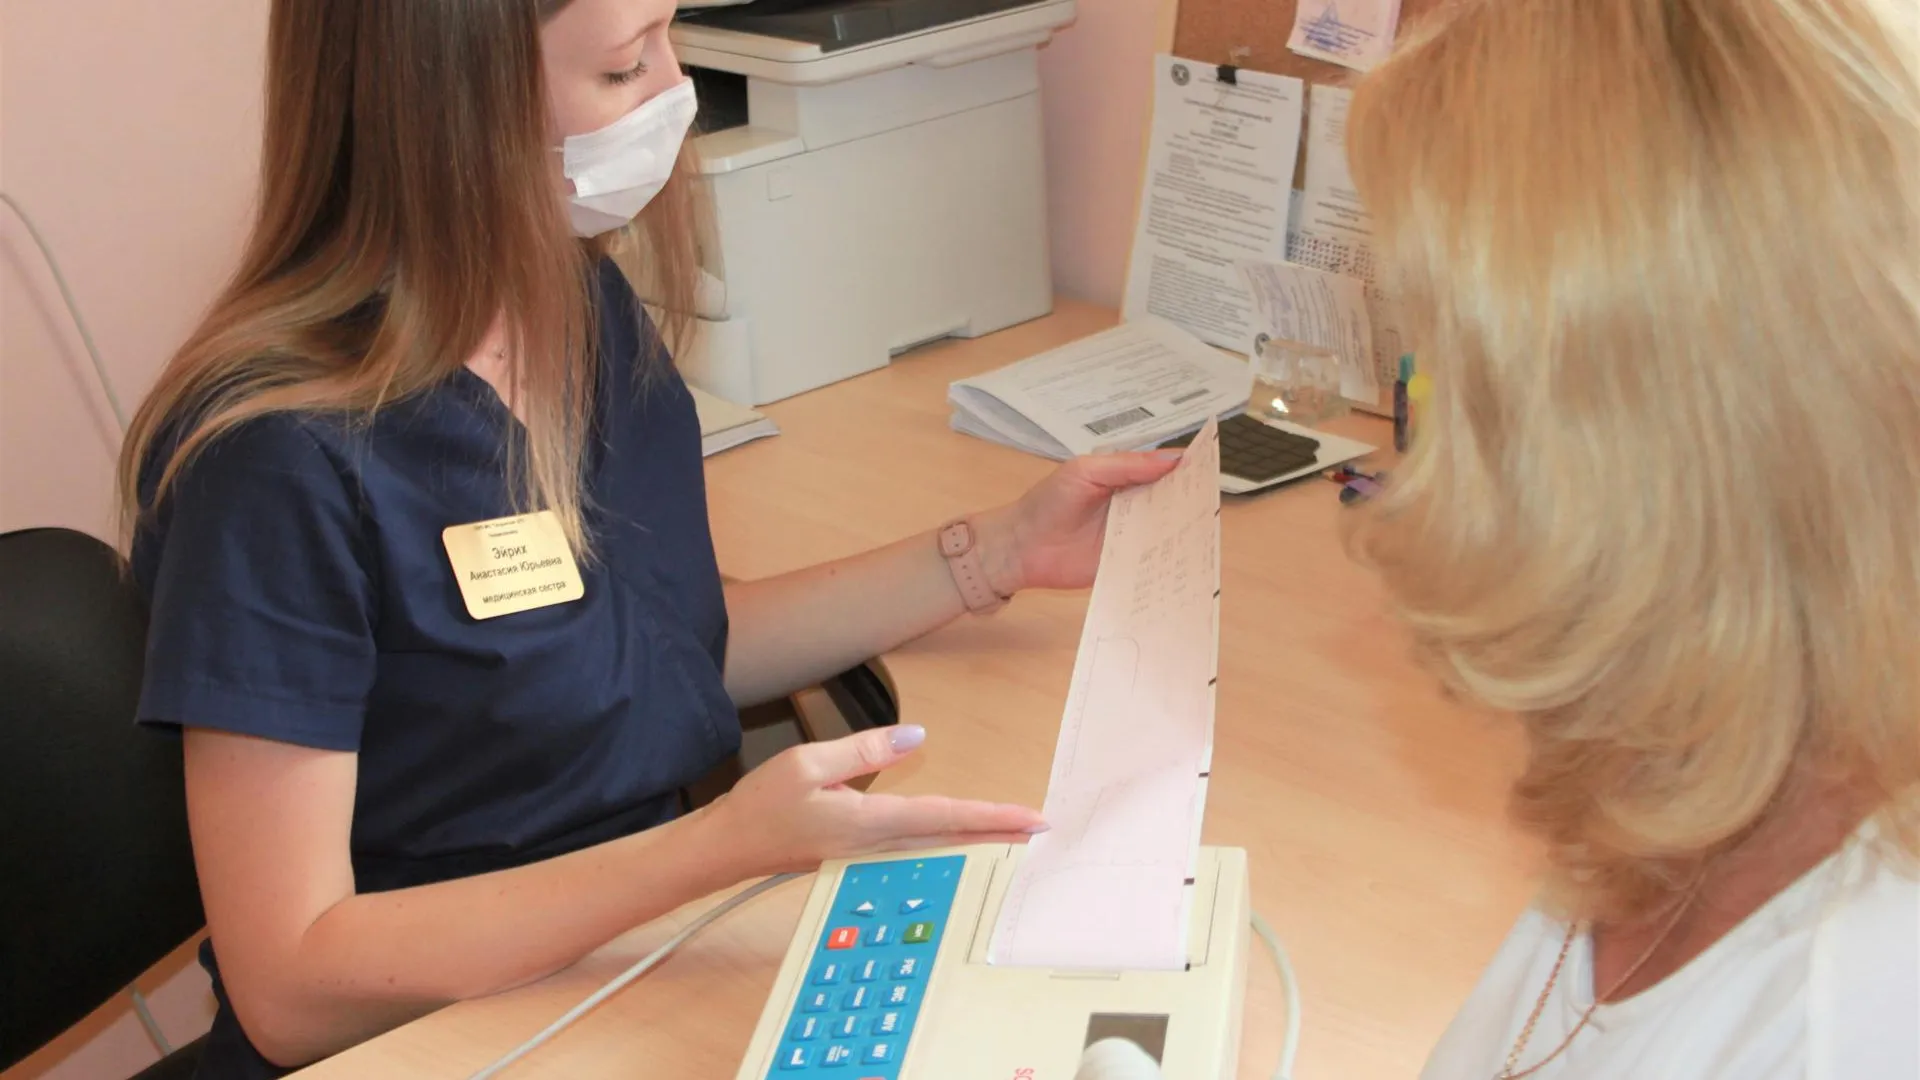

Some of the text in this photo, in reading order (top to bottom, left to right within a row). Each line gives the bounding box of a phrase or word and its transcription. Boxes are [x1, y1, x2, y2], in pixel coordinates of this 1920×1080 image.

[492, 545, 527, 560] Эйрих
[470, 556, 562, 581] Анастасия Юрьевна
[482, 581, 566, 604] медицинская сестра
